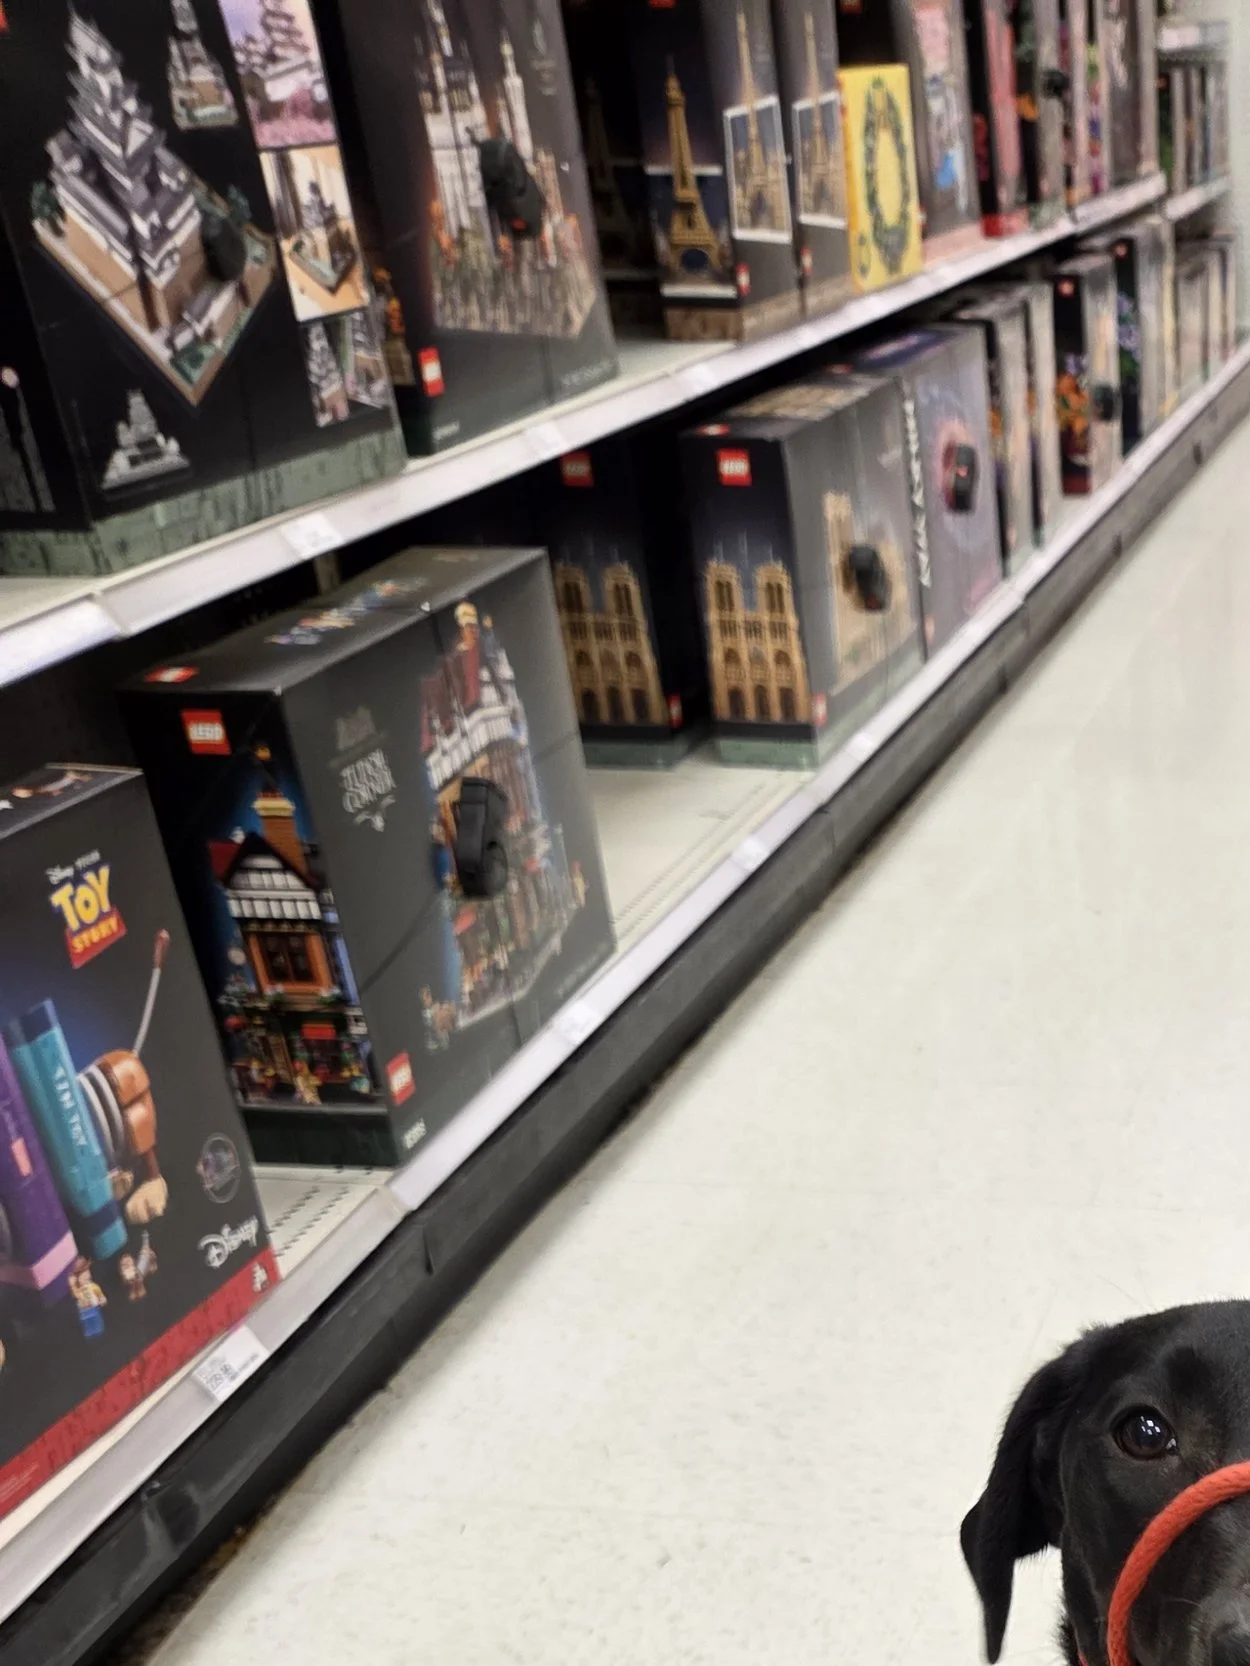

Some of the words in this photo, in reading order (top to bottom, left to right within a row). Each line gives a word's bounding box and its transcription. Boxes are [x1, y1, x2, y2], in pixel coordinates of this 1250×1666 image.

[189, 721, 225, 744] LEGO
[50, 865, 111, 932] TOY
[71, 915, 119, 954] STORY
[199, 1215, 259, 1268] Disney
